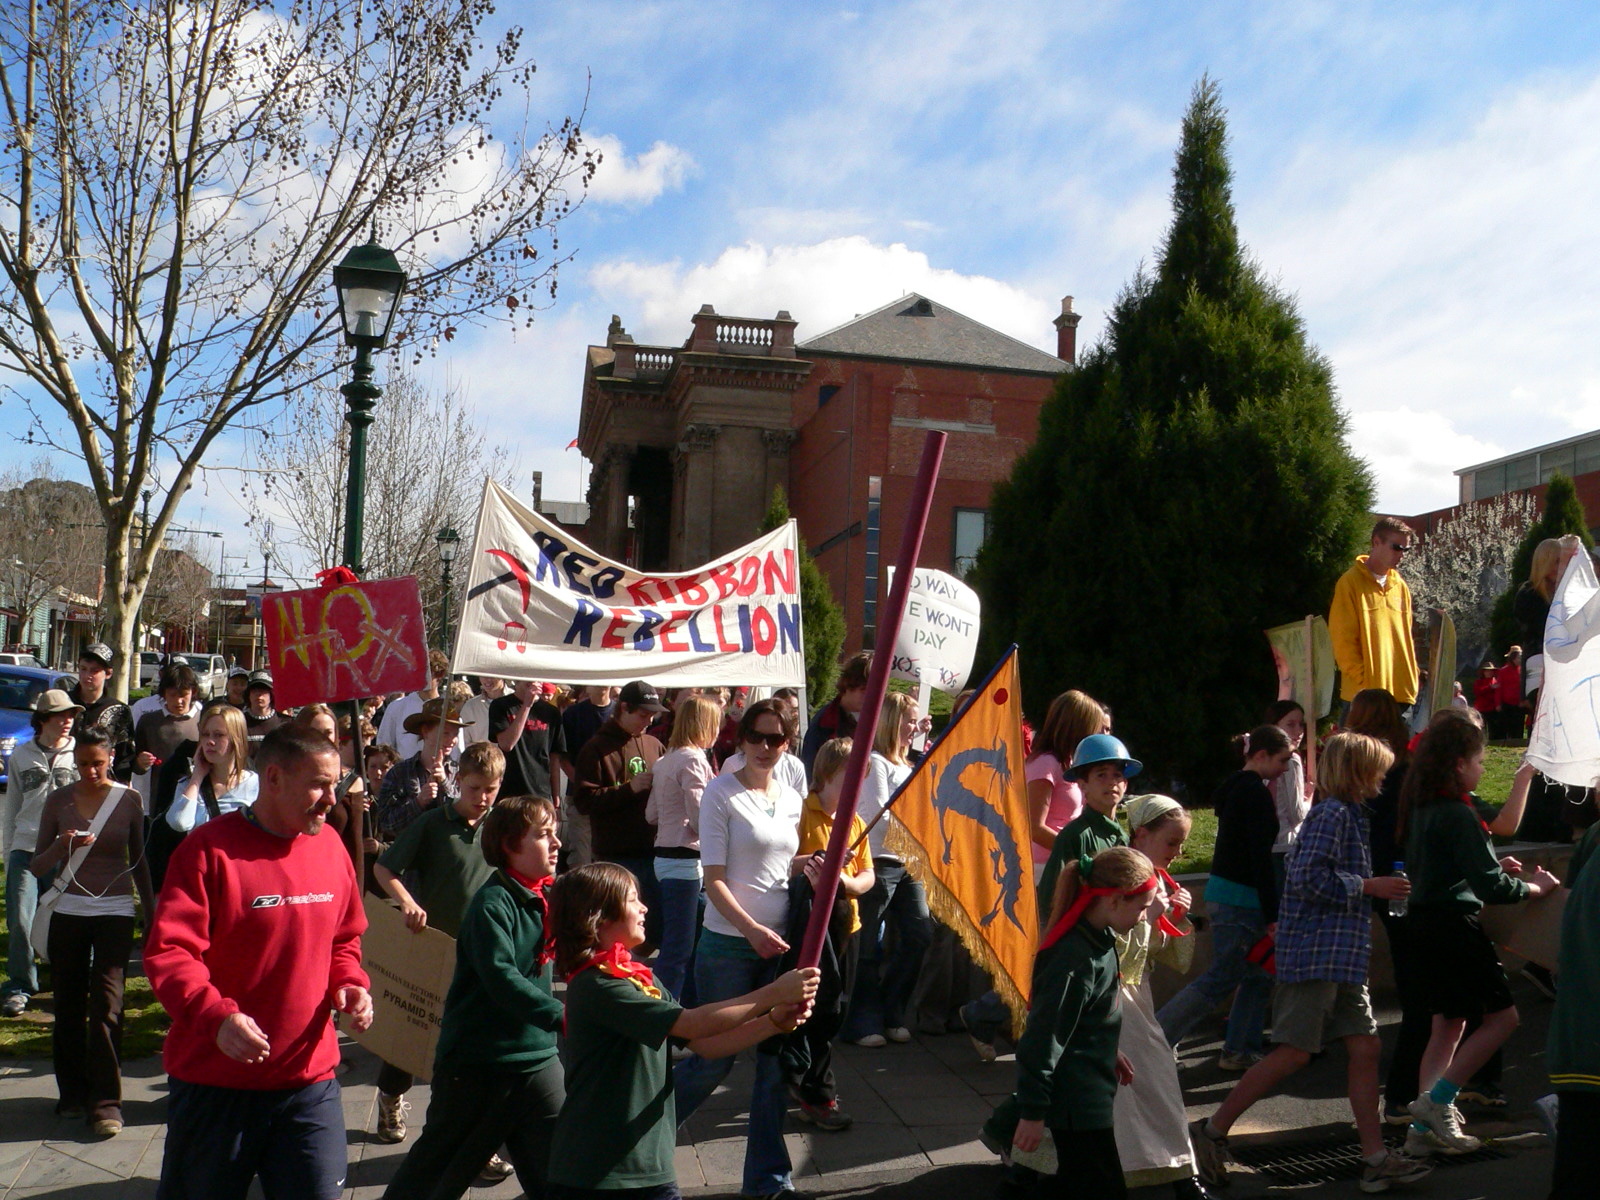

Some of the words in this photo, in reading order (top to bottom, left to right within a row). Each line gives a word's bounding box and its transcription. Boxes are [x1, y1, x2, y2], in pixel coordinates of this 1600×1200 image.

[533, 531, 626, 599] RED
[627, 549, 795, 607] RIBBON
[926, 575, 959, 599] WAY
[274, 586, 376, 671] NO
[564, 599, 800, 656] REBELLION
[914, 629, 947, 650] PAY
[926, 607, 973, 637] WONT
[281, 615, 417, 698] TAX
[383, 989, 426, 1018] PYRAMID
